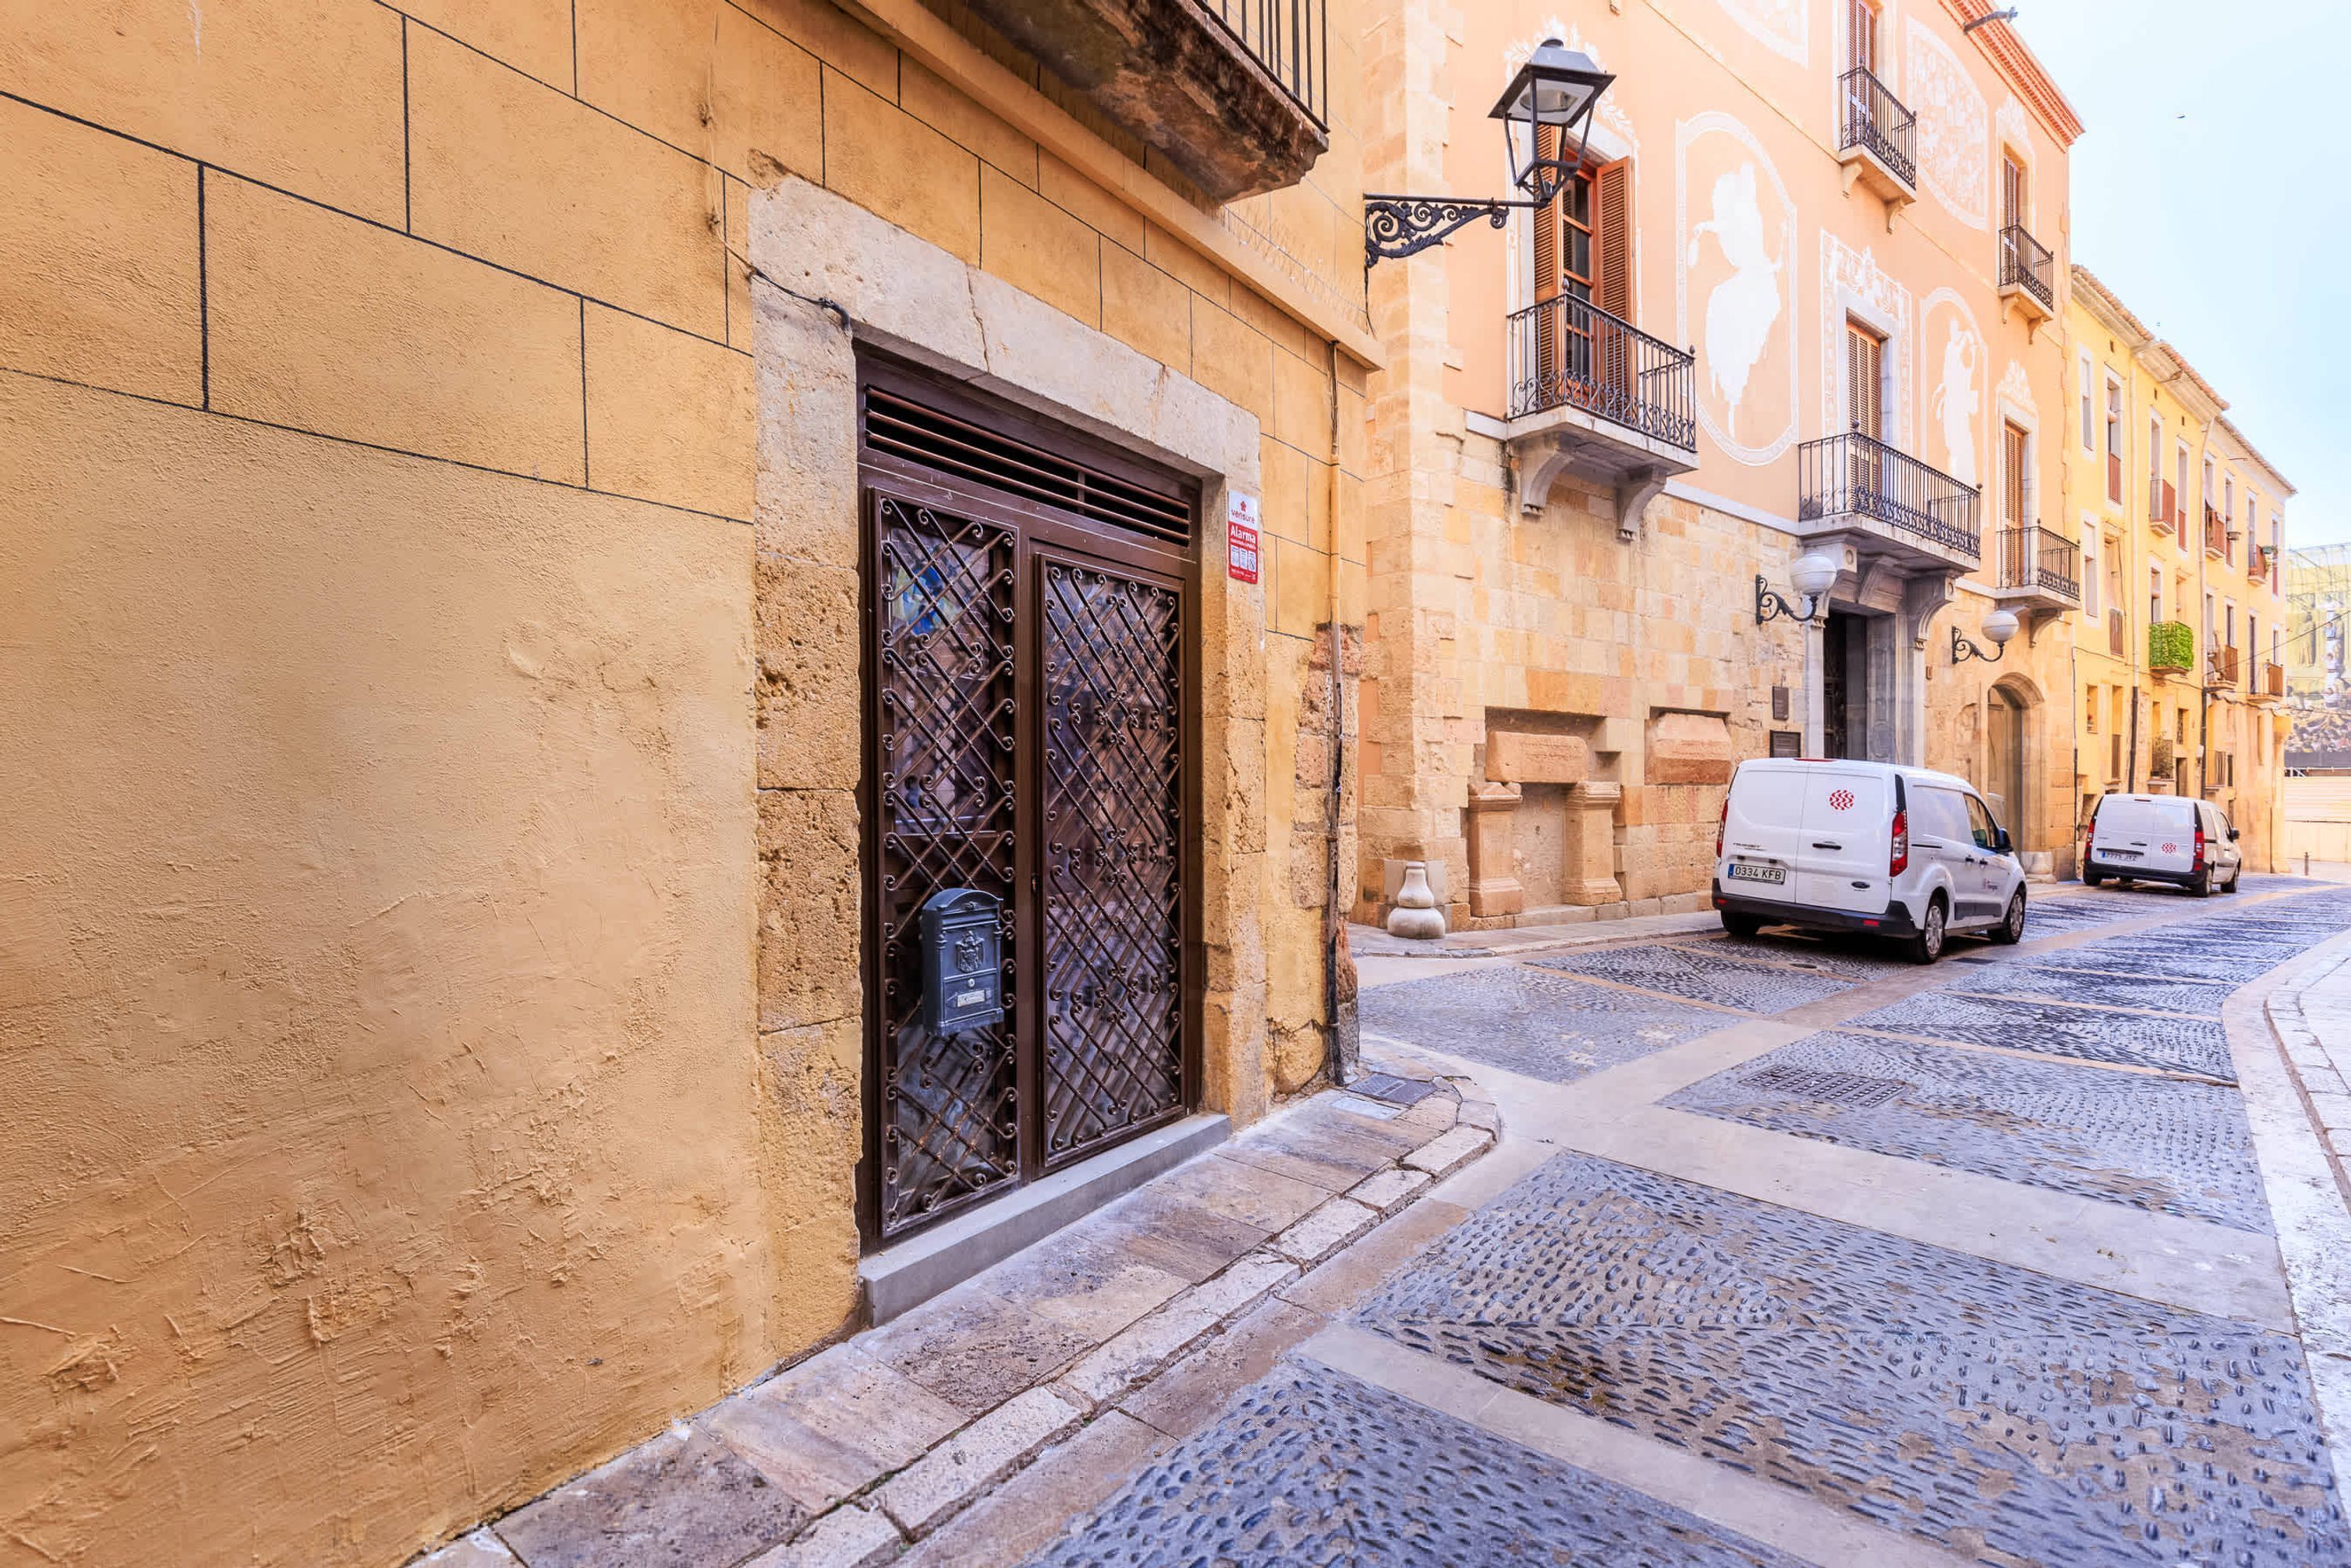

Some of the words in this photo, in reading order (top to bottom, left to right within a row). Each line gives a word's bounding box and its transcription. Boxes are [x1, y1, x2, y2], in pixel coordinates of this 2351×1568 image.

[1230, 525, 1255, 544] Alarma
[1735, 867, 1759, 877] 0334
[1762, 869, 1781, 880] KFB
